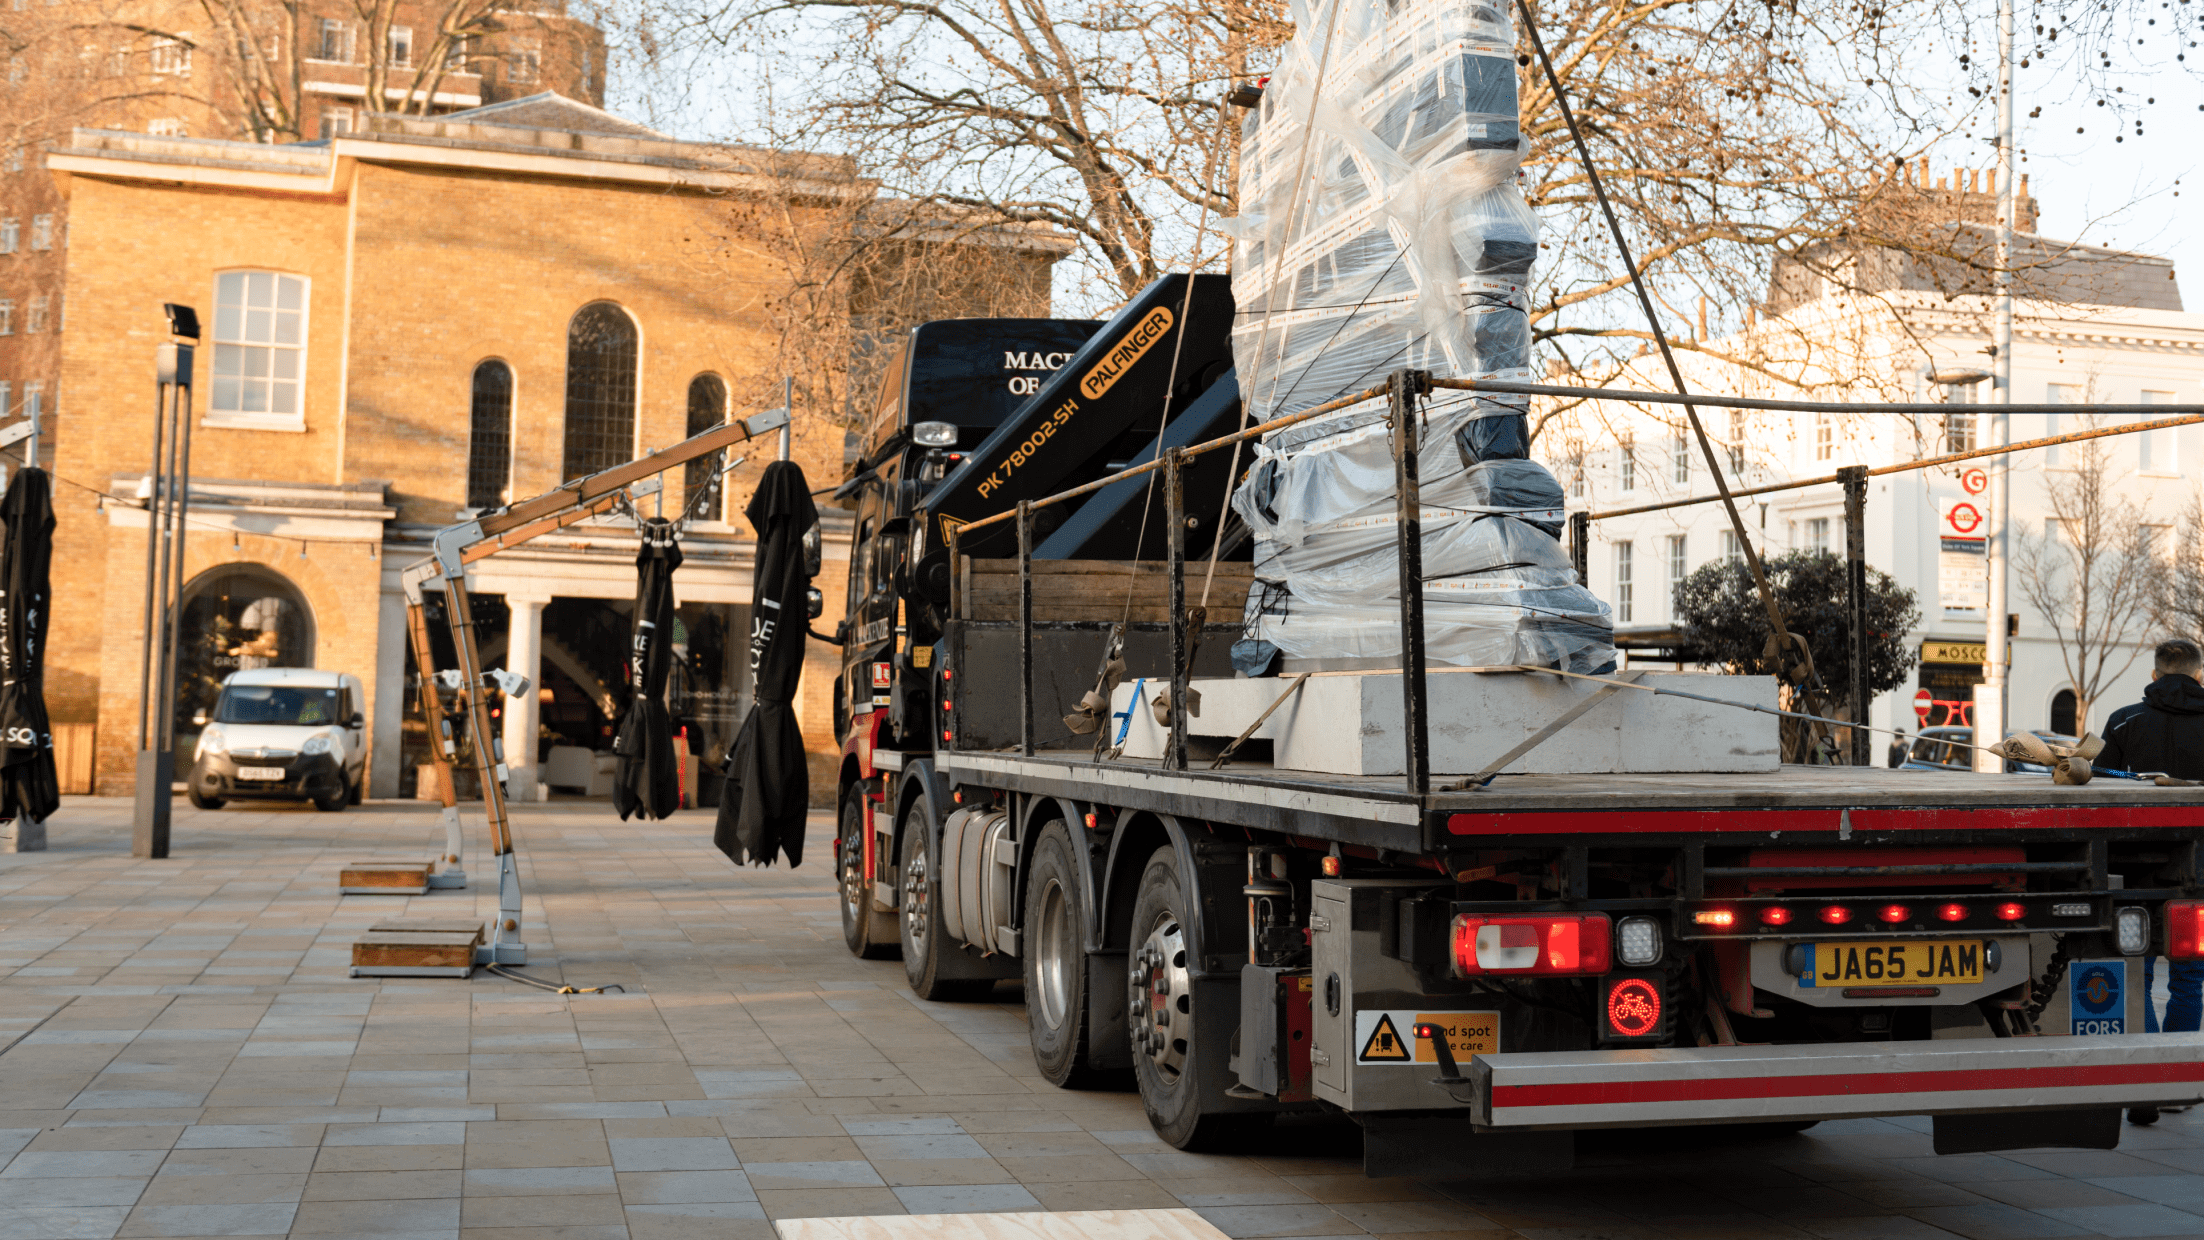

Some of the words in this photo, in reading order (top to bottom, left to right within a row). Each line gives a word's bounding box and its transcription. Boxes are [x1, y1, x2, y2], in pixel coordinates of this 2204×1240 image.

[1085, 312, 1169, 395] PALFINGER
[977, 472, 1004, 499] PK
[999, 398, 1080, 477] 78002-SH
[1822, 945, 1906, 981] JA65
[1916, 944, 1977, 978] JAM
[1802, 970, 1814, 980] GB
[1461, 1026, 1491, 1039] spot
[2076, 1020, 2121, 1036] FORS
[1460, 1042, 1484, 1051] care
